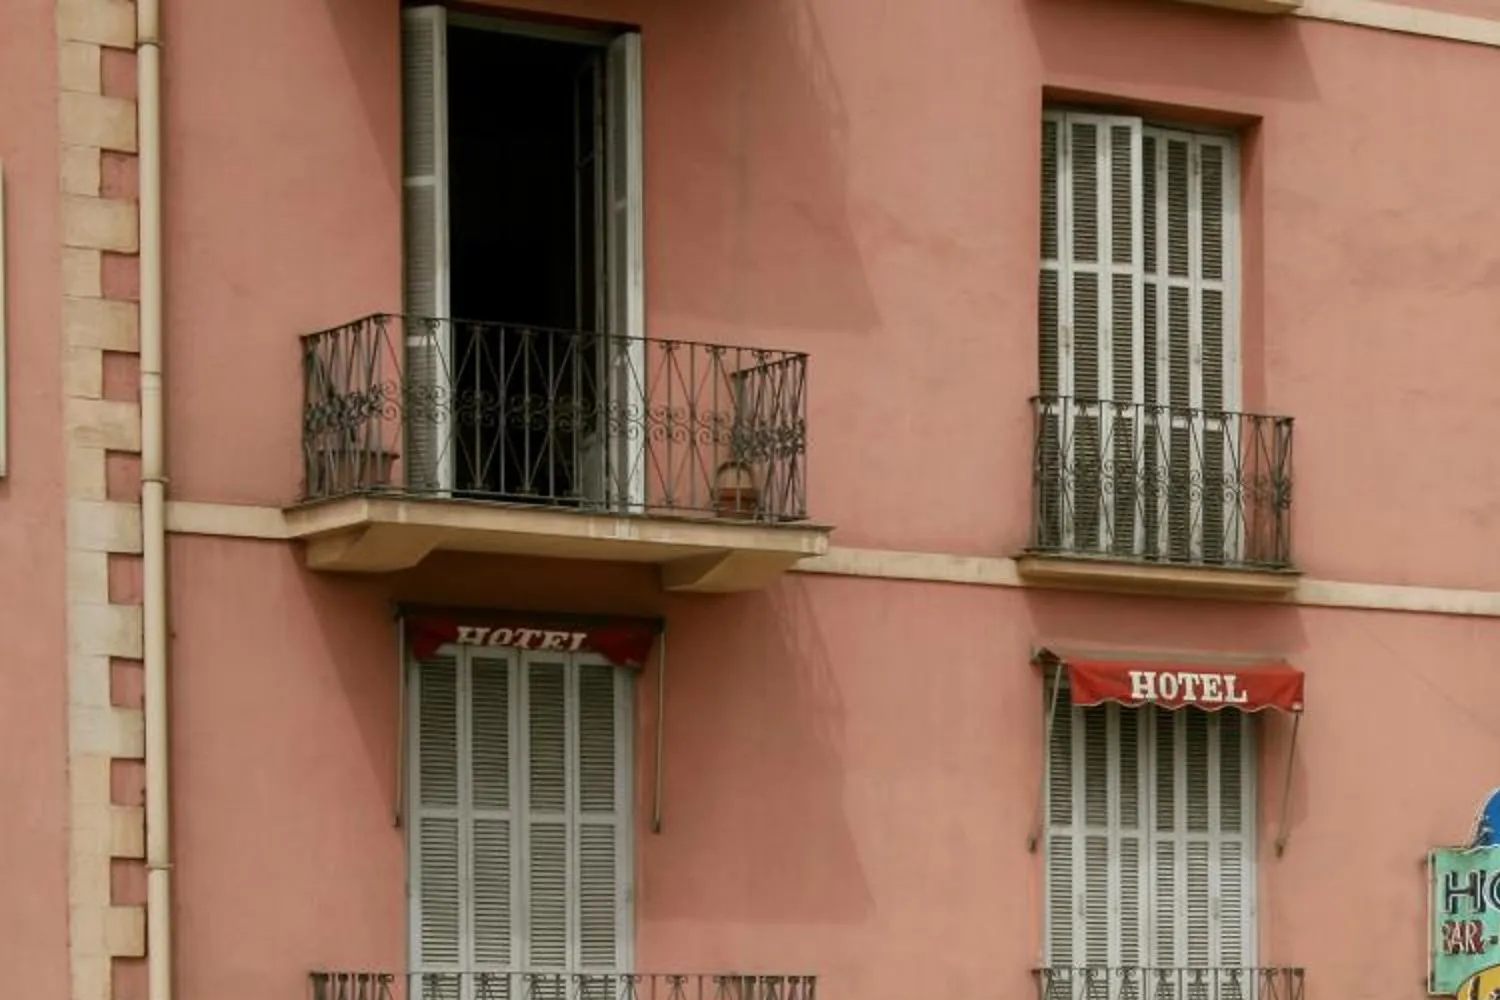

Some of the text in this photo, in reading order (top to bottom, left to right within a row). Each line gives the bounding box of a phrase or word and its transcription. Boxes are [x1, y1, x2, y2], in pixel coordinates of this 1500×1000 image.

[456, 626, 588, 650] HOTEL
[1128, 670, 1248, 703] HOTEL
[1442, 919, 1485, 956] BAR
